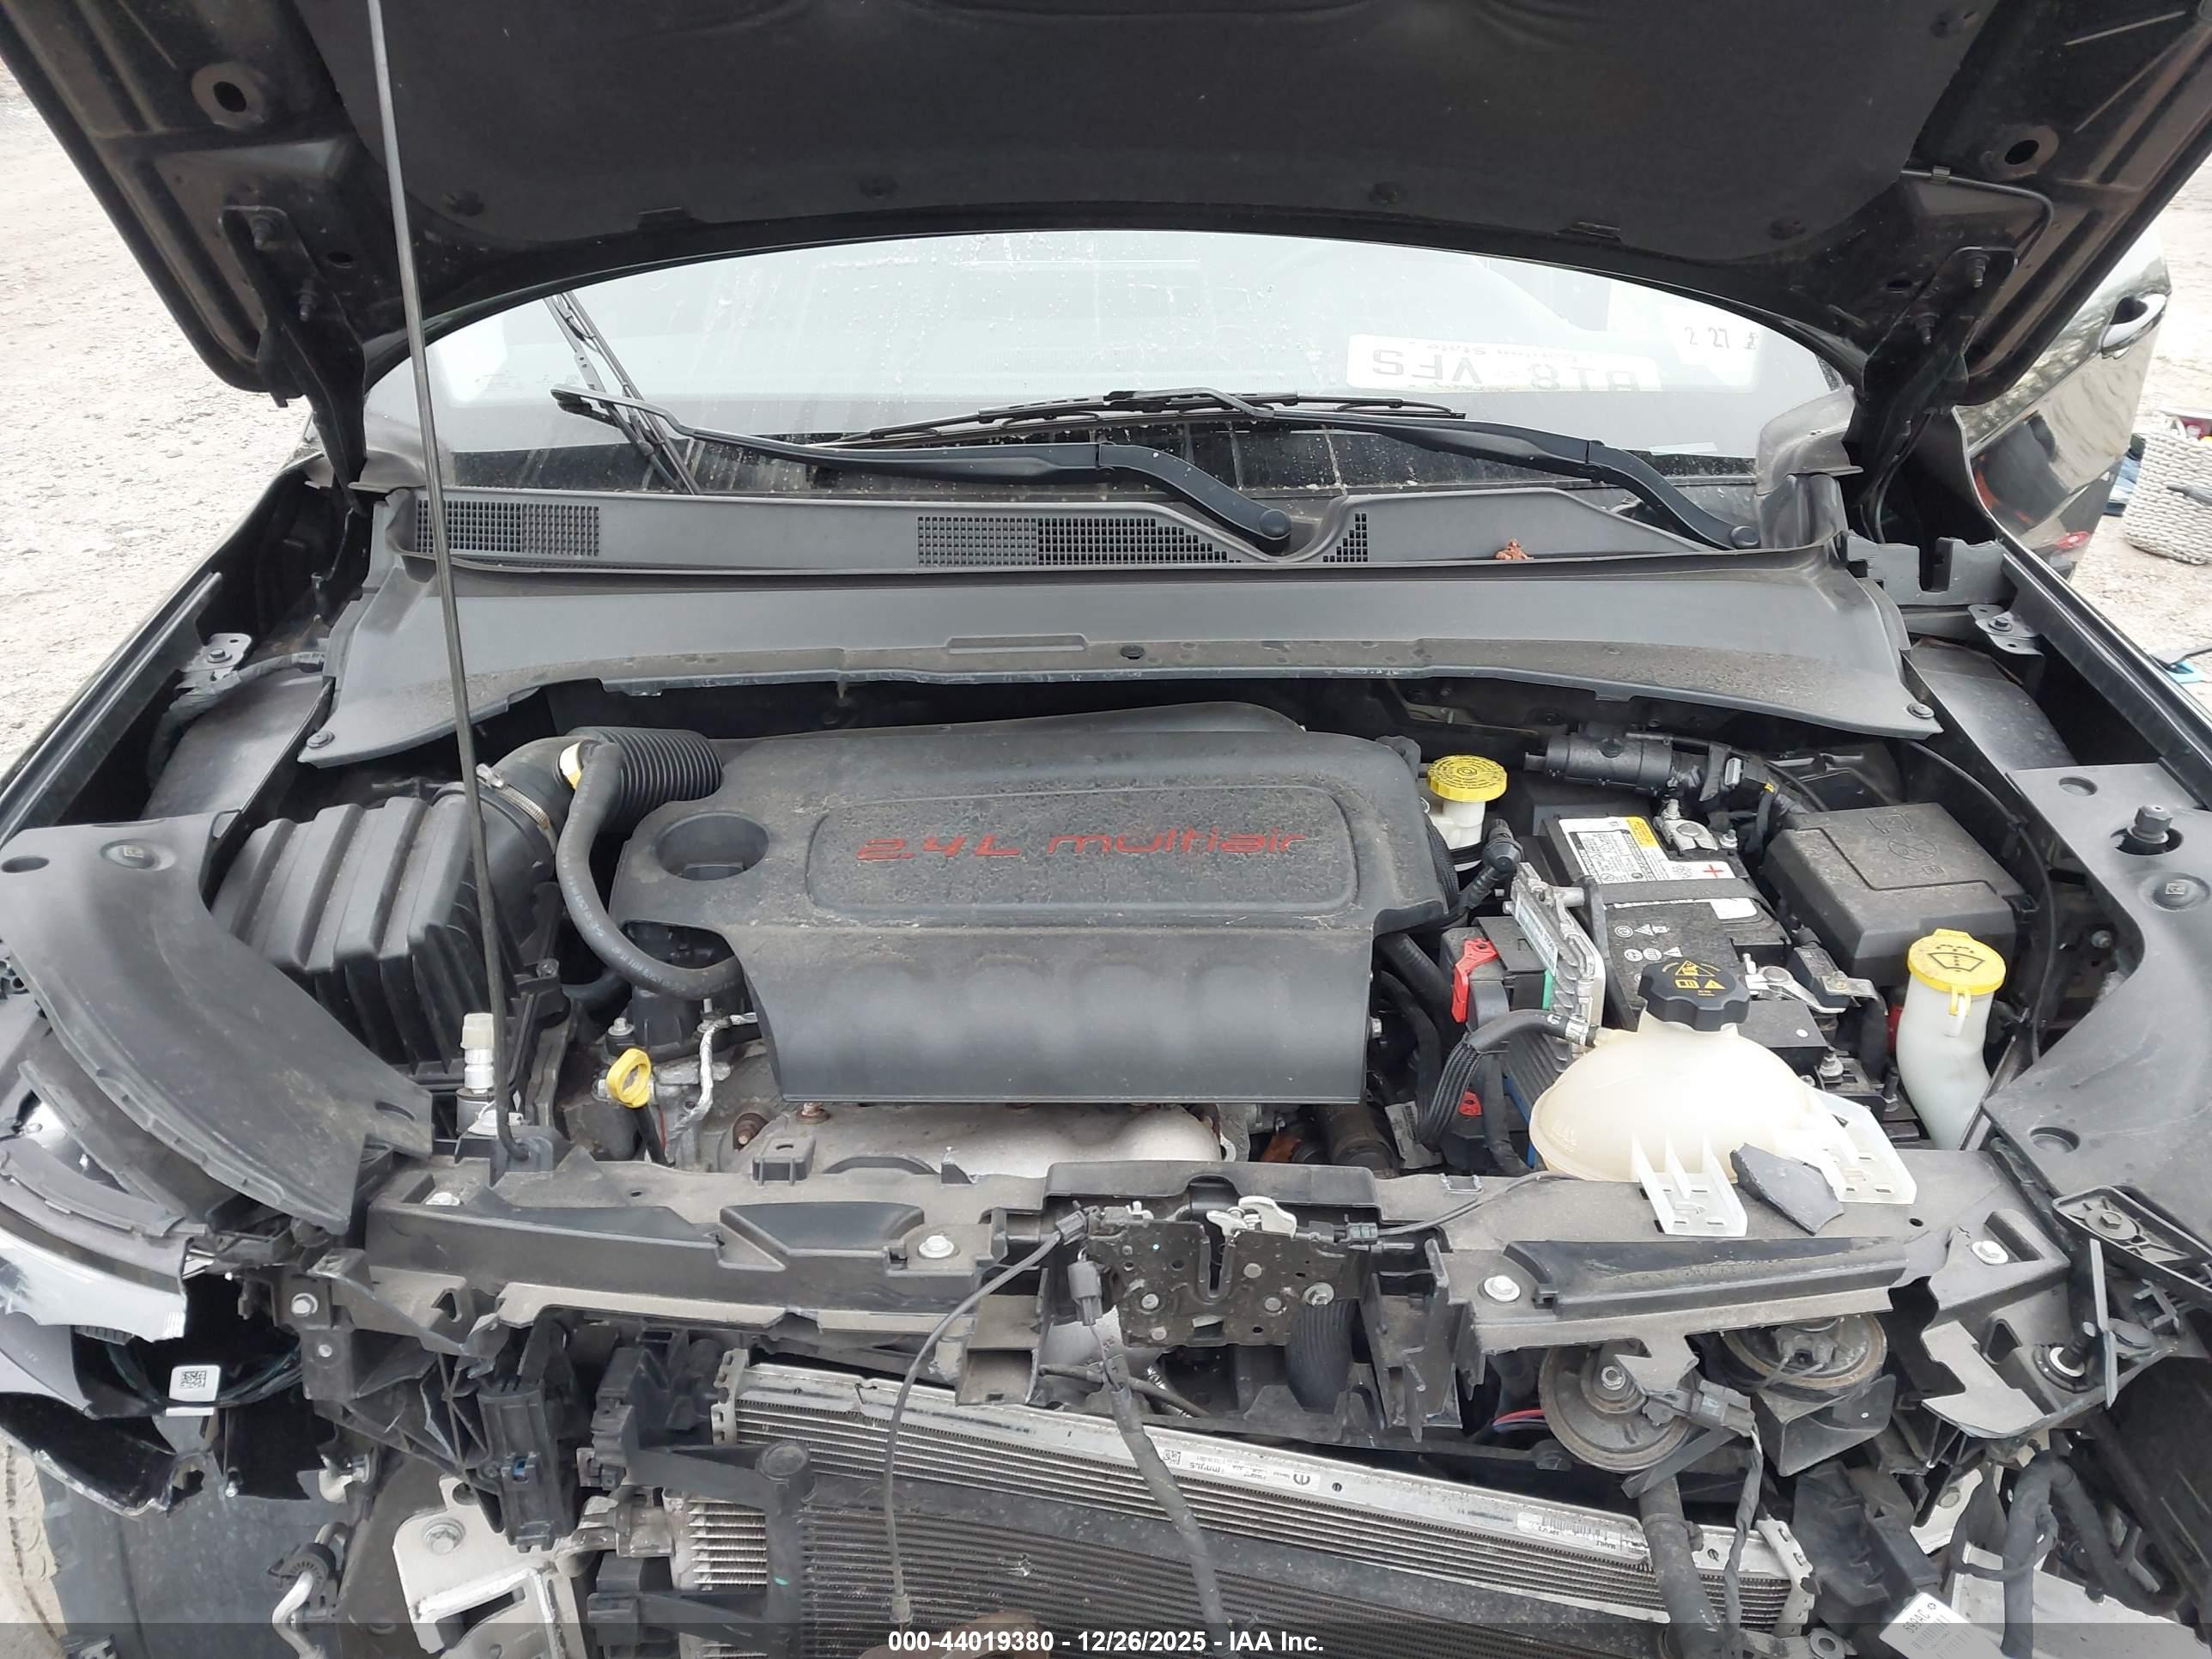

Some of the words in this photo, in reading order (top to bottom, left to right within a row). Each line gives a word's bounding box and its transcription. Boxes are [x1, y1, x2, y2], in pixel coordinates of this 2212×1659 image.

[1372, 349, 1482, 385] VFS
[856, 834, 1020, 860] 2.4L
[1048, 825, 1306, 854] multiair
